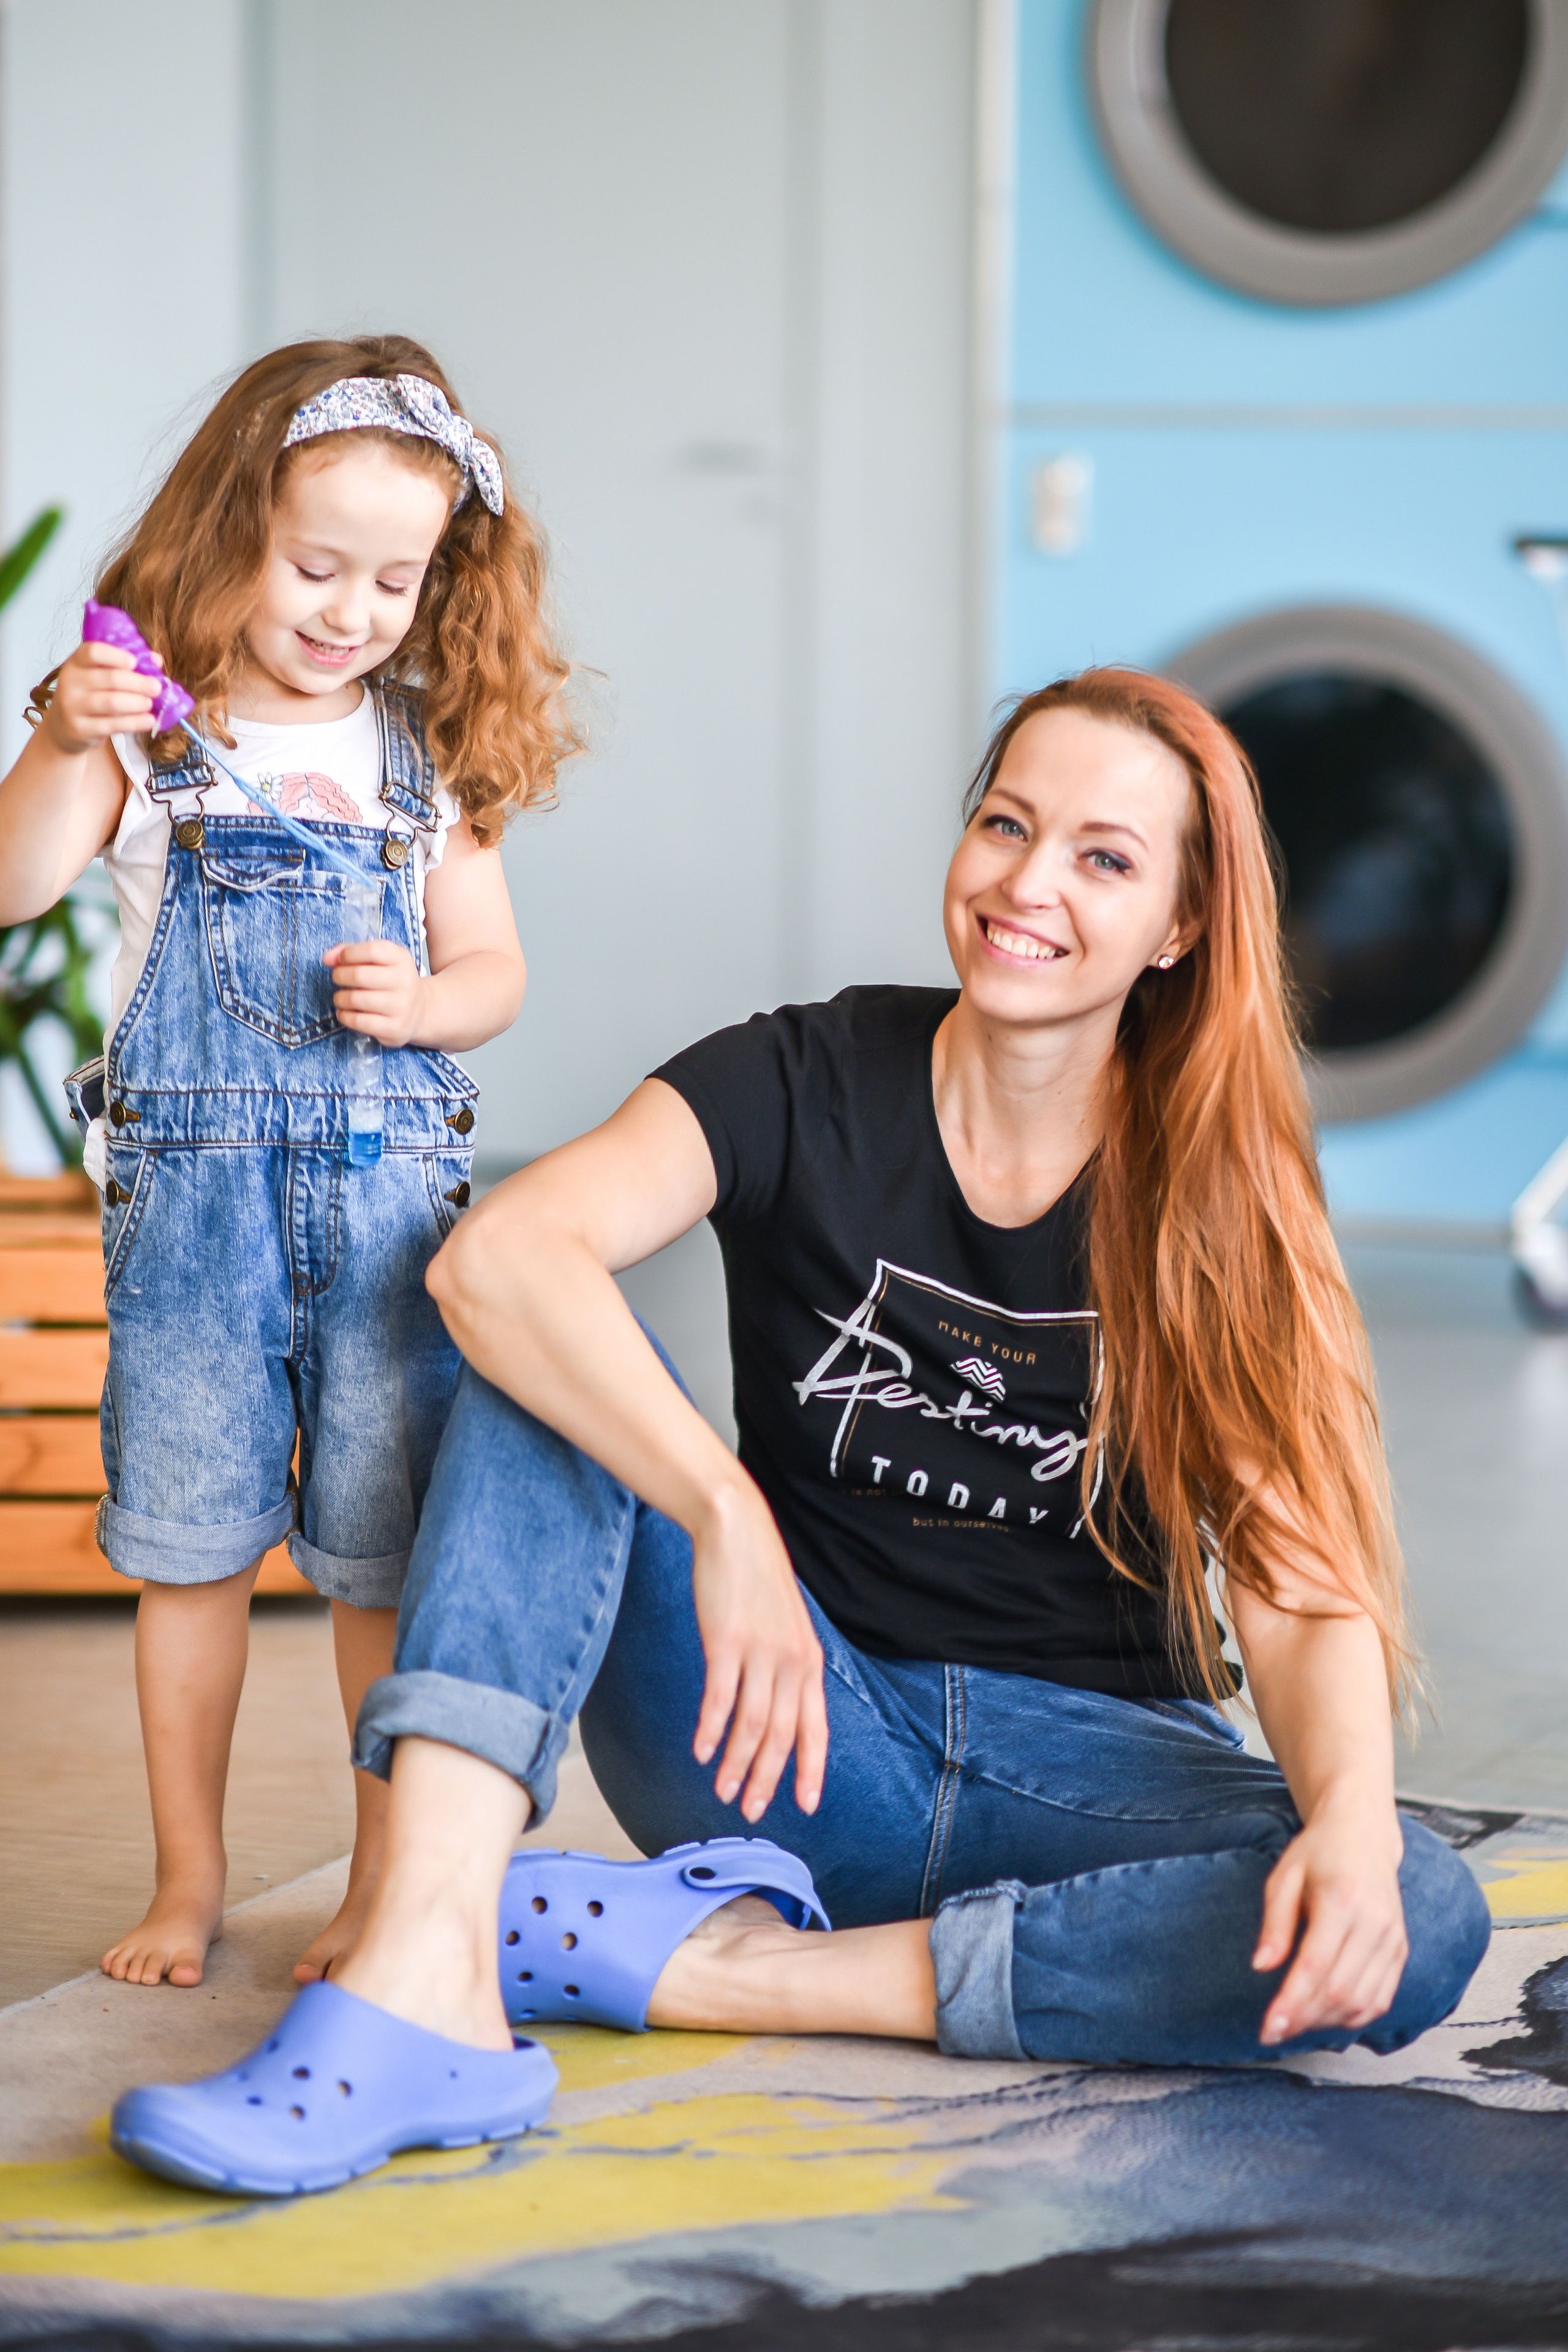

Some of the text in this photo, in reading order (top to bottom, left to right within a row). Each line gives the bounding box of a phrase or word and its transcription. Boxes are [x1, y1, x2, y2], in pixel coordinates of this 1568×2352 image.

[938, 1319, 1036, 1365] MAKE YOUR
[871, 1455, 1049, 1524] TODAY
[913, 1517, 933, 1527] but
[938, 1518, 949, 1527] in
